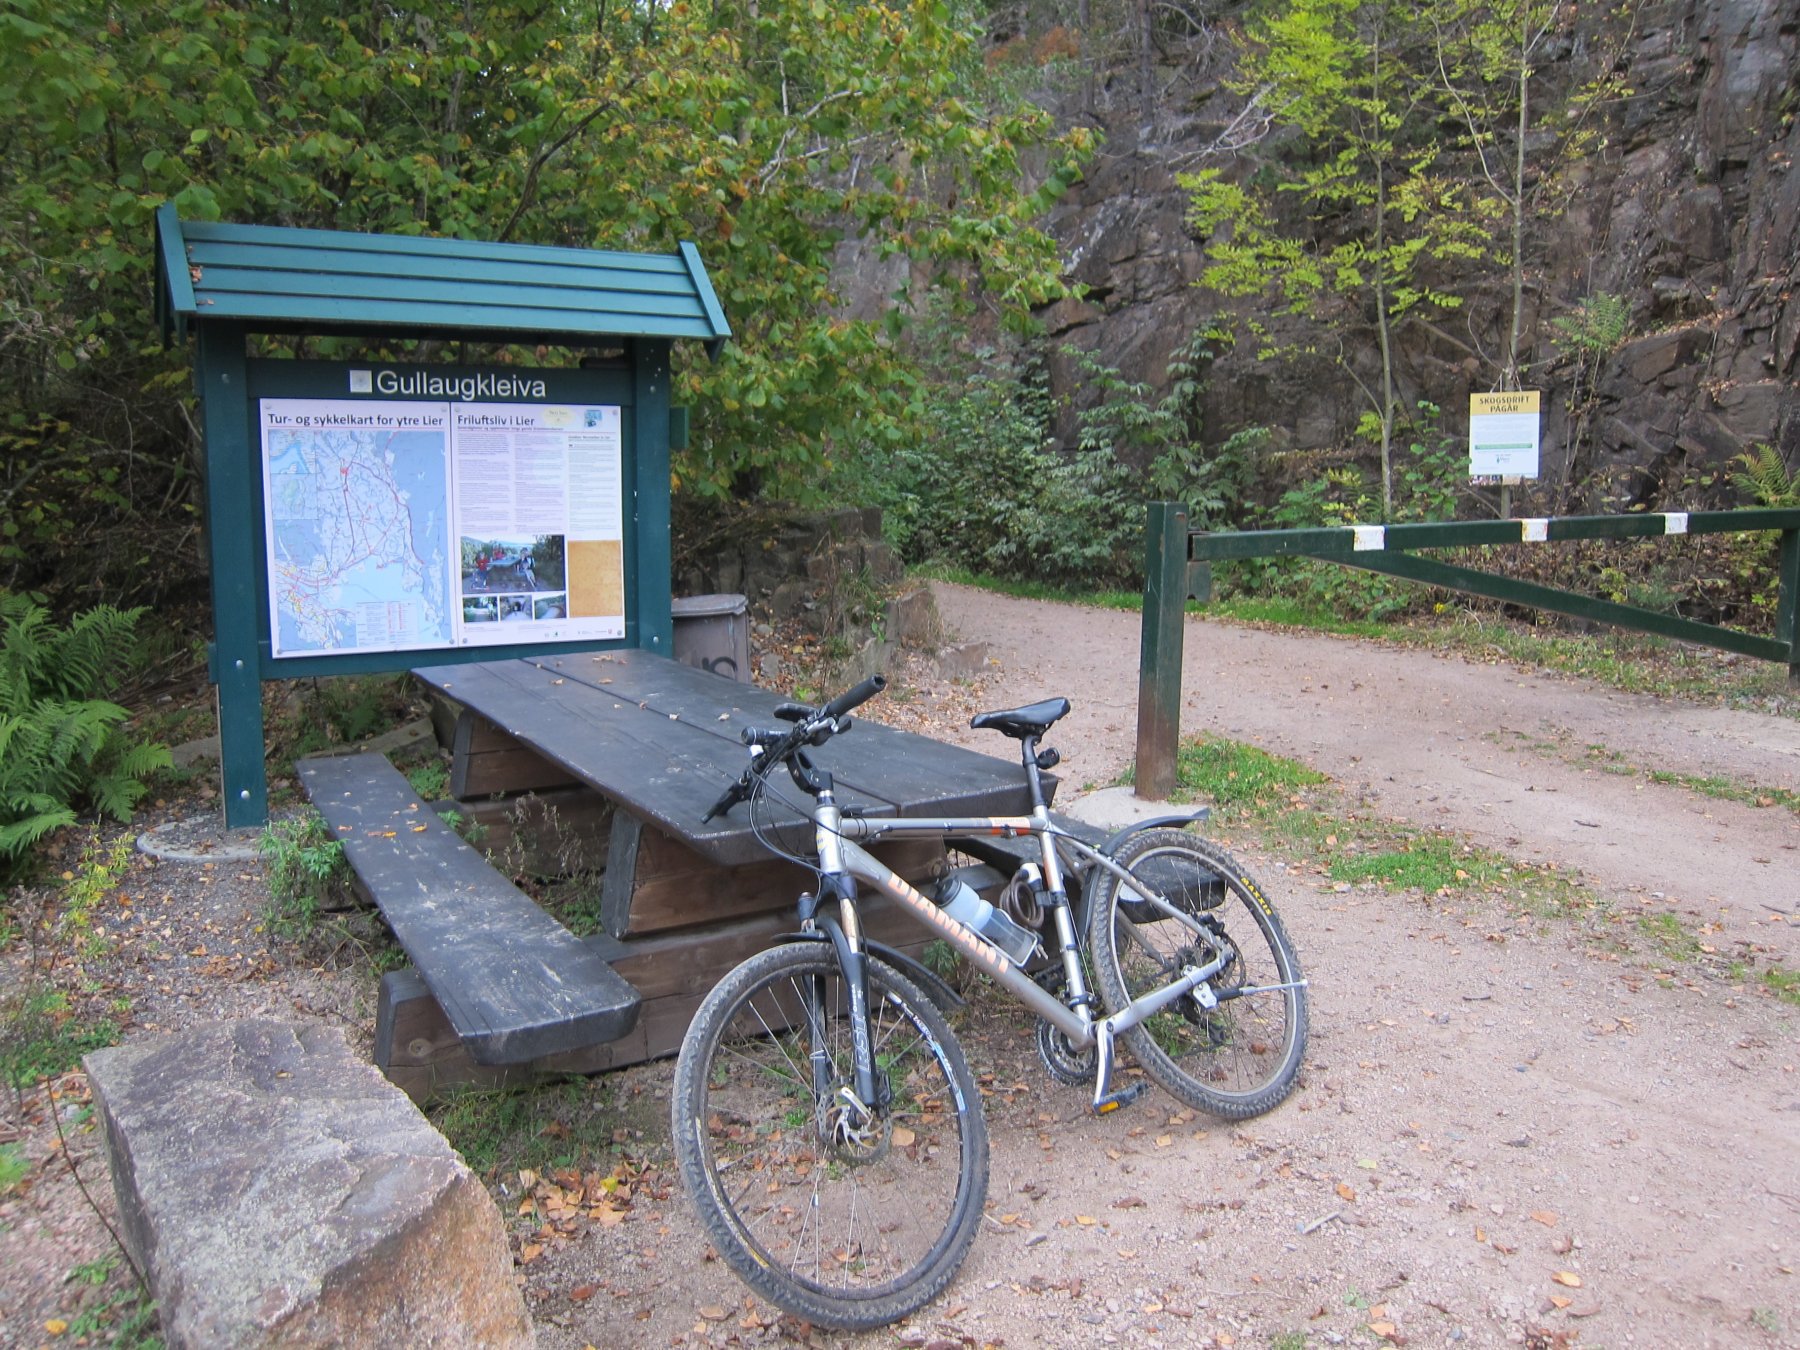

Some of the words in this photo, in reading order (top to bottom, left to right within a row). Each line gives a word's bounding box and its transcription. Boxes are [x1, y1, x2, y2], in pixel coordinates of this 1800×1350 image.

[377, 370, 546, 401] Gullaugkleiva
[267, 413, 293, 424] Tur-
[295, 416, 311, 427] og
[314, 414, 373, 427] sykkelkart
[377, 414, 394, 425] for
[396, 415, 420, 427] ytre
[423, 415, 444, 426] Lier
[457, 414, 507, 426] Friluftsliv
[516, 415, 536, 426] Lier
[1490, 403, 1519, 413] PÅGÅR
[1240, 876, 1272, 916] MAXXIS
[888, 872, 1010, 975] DIAMANT
[851, 1013, 871, 1074] RST
